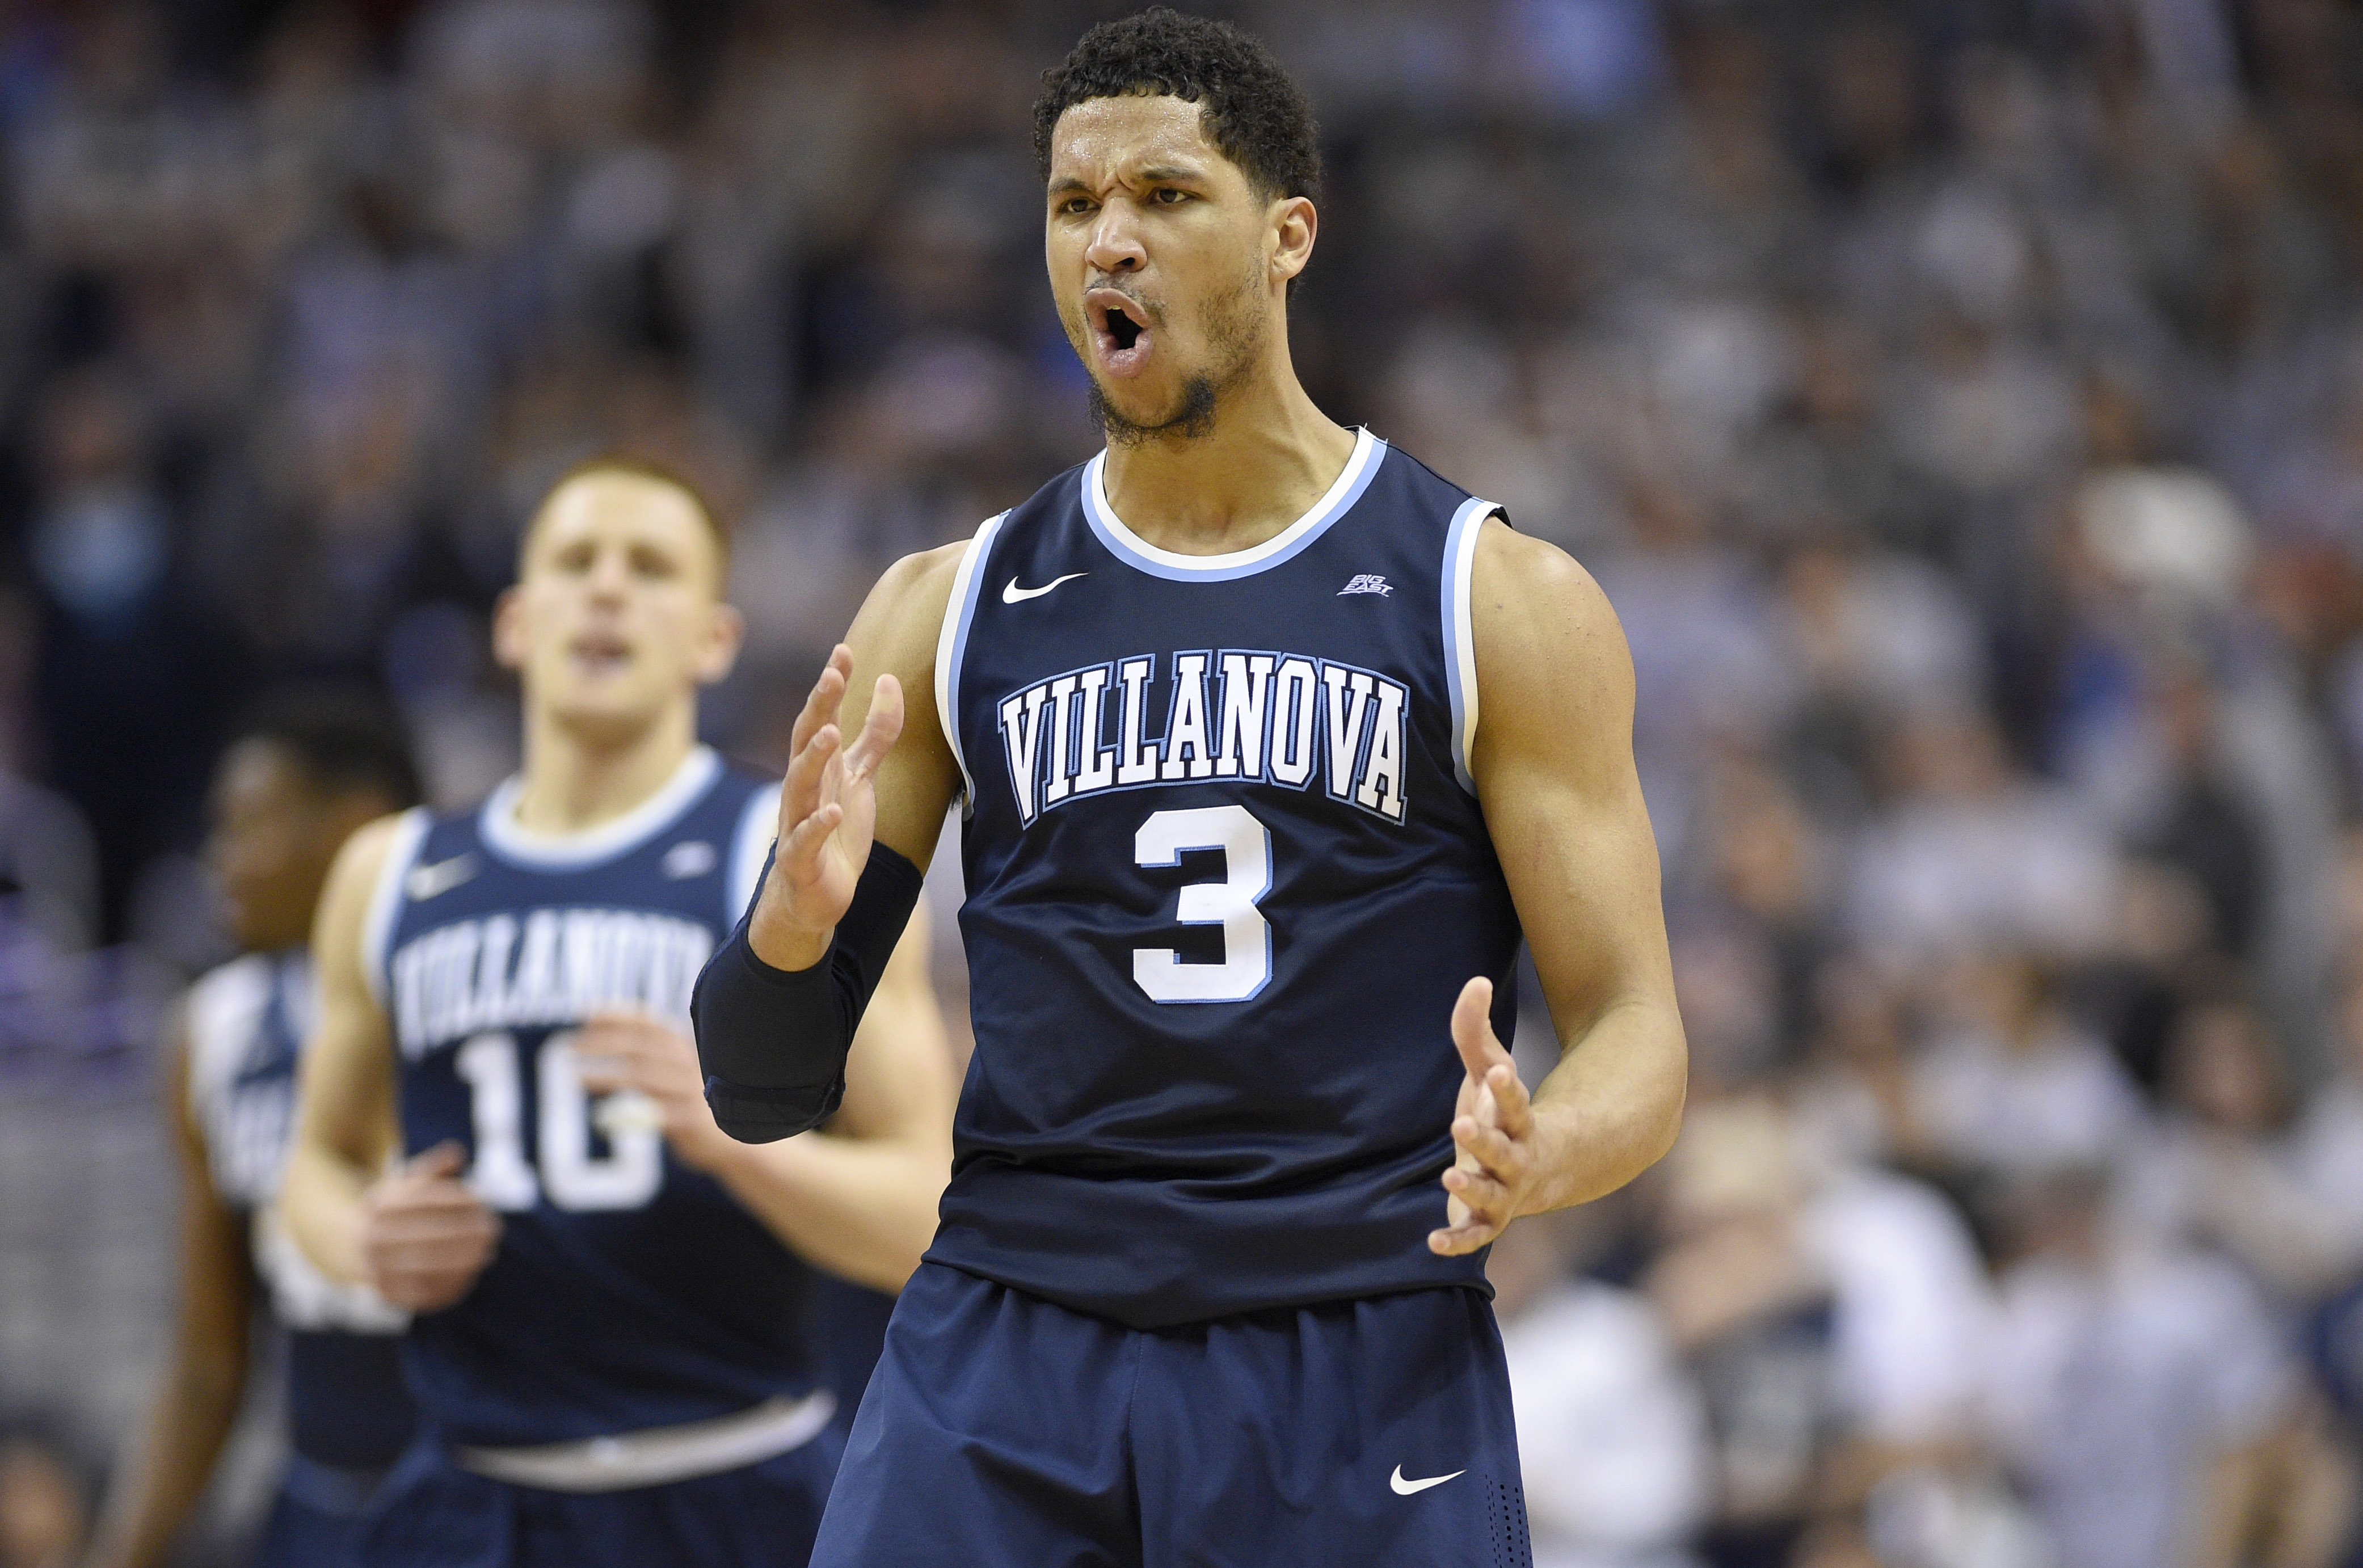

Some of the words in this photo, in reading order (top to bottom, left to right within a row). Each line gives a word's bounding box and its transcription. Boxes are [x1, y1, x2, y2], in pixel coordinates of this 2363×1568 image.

[1342, 583, 1394, 593] EAST
[1349, 574, 1386, 584] BIG
[997, 649, 1410, 830] VILLANOVA
[1134, 805, 1273, 1004] 3
